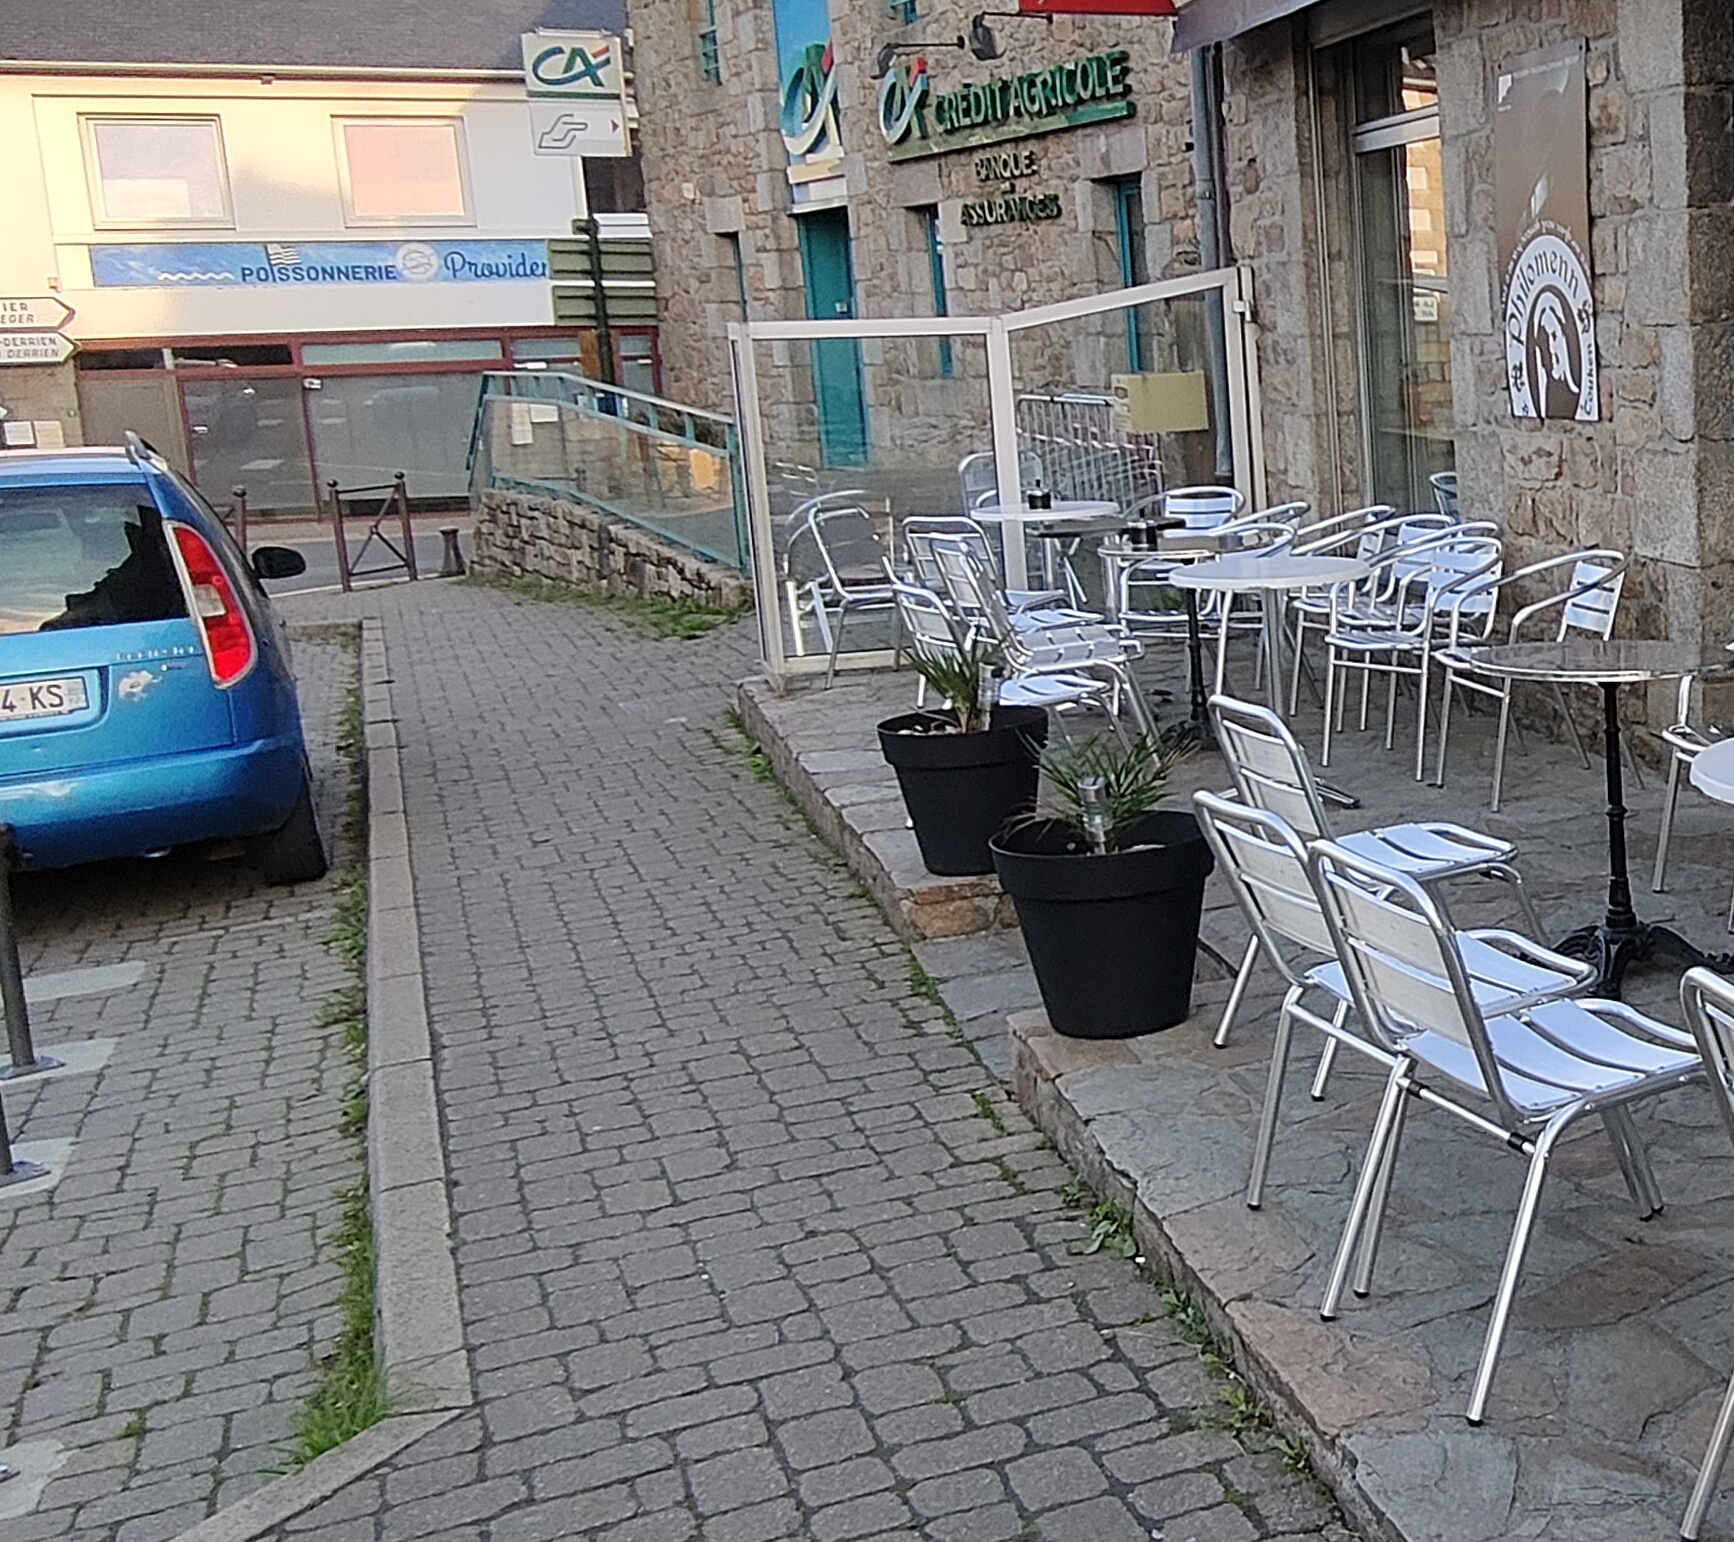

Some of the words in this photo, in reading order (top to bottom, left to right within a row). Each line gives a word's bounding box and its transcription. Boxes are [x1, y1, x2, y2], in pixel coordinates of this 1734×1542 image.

[1009, 56, 1128, 117] AGRICOLE
[974, 151, 1033, 181] BANQUE
[241, 263, 397, 282] POISSONNERIE
[1507, 250, 1579, 347] Philomenn
